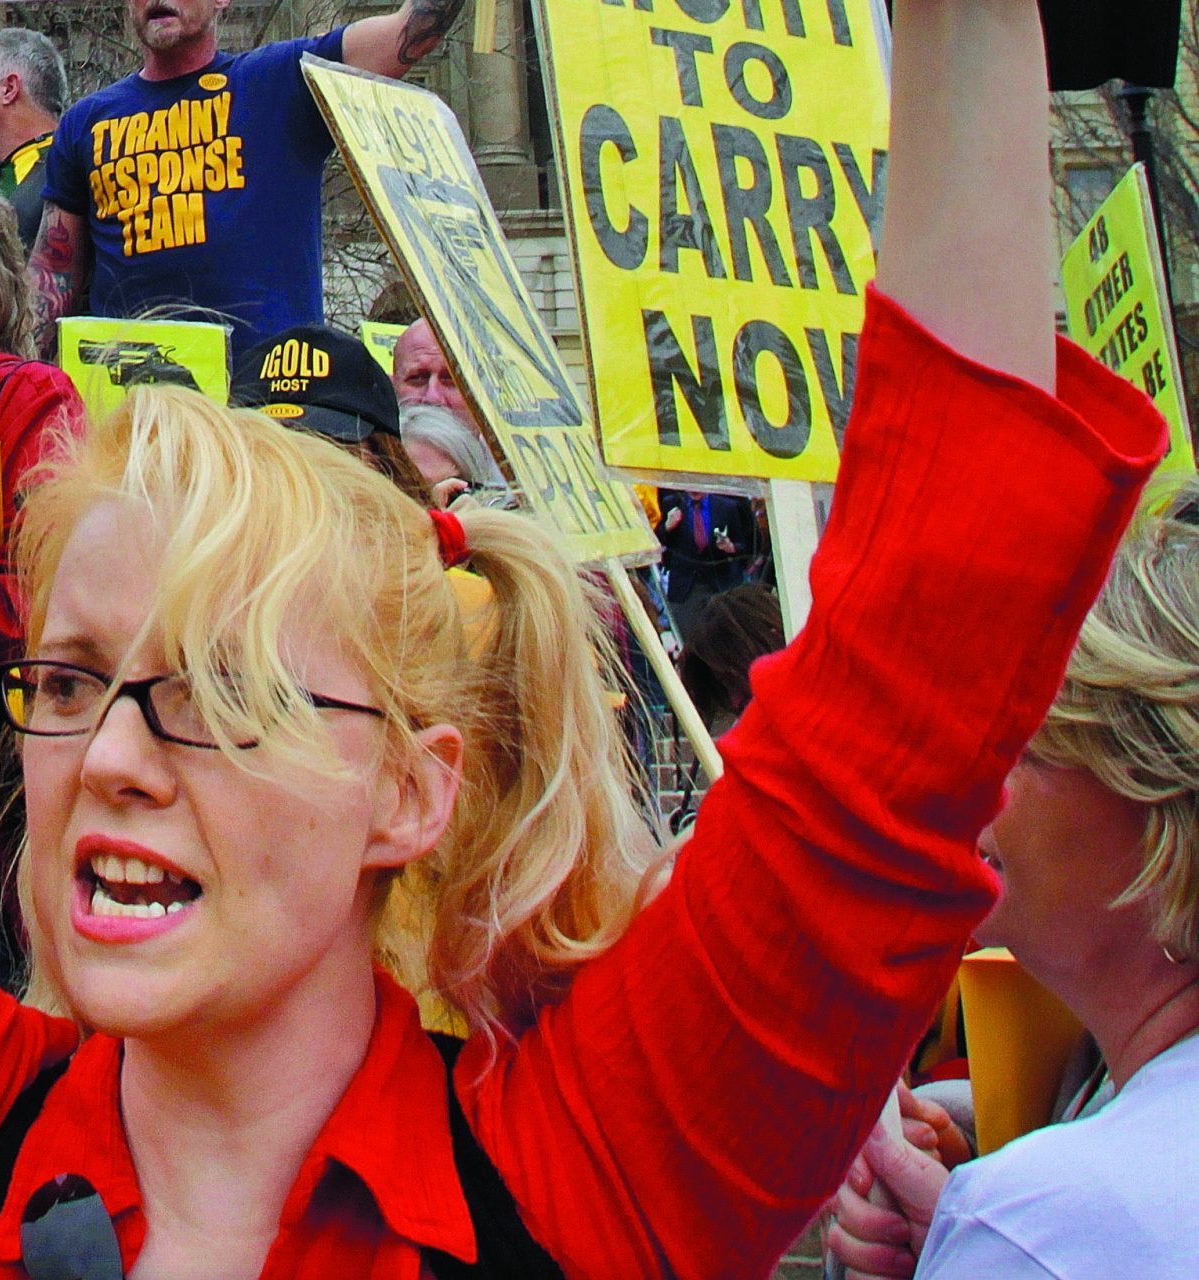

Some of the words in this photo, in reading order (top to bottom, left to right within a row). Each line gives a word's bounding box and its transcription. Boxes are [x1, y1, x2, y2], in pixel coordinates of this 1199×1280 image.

[650, 26, 792, 120] TO
[91, 91, 232, 166] TYRANNY
[393, 106, 467, 187] 911
[89, 136, 246, 219] RESPONSE
[580, 103, 889, 296] CARRY
[117, 192, 207, 257] TEAM
[1084, 251, 1134, 337] OTHER
[259, 338, 330, 380] IGOLD
[1095, 302, 1148, 371] TATES
[1142, 349, 1166, 399] BE
[270, 379, 310, 393] HOST
